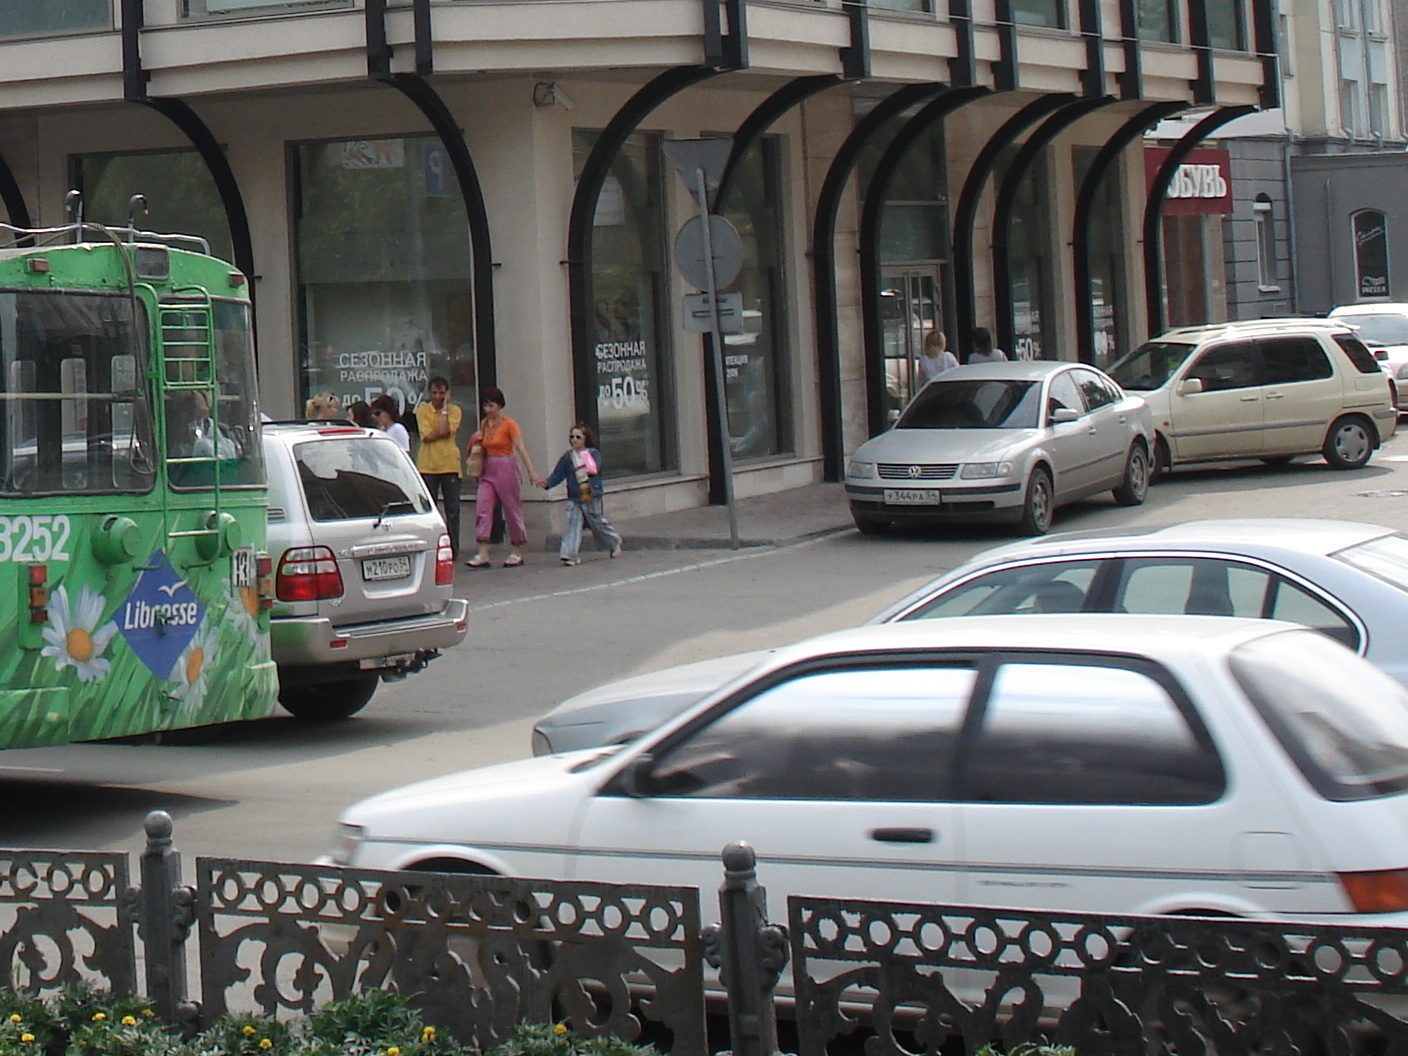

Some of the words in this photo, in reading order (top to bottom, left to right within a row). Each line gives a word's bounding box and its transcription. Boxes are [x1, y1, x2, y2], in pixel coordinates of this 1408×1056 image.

[339, 350, 427, 368] СЕЗОННАЯ
[595, 341, 646, 359] СЕЗОННАЯ
[597, 357, 646, 374] РАСПРОДАЖА
[340, 369, 428, 382] РАСПРОДАЖА
[124, 602, 198, 630] Libresse
